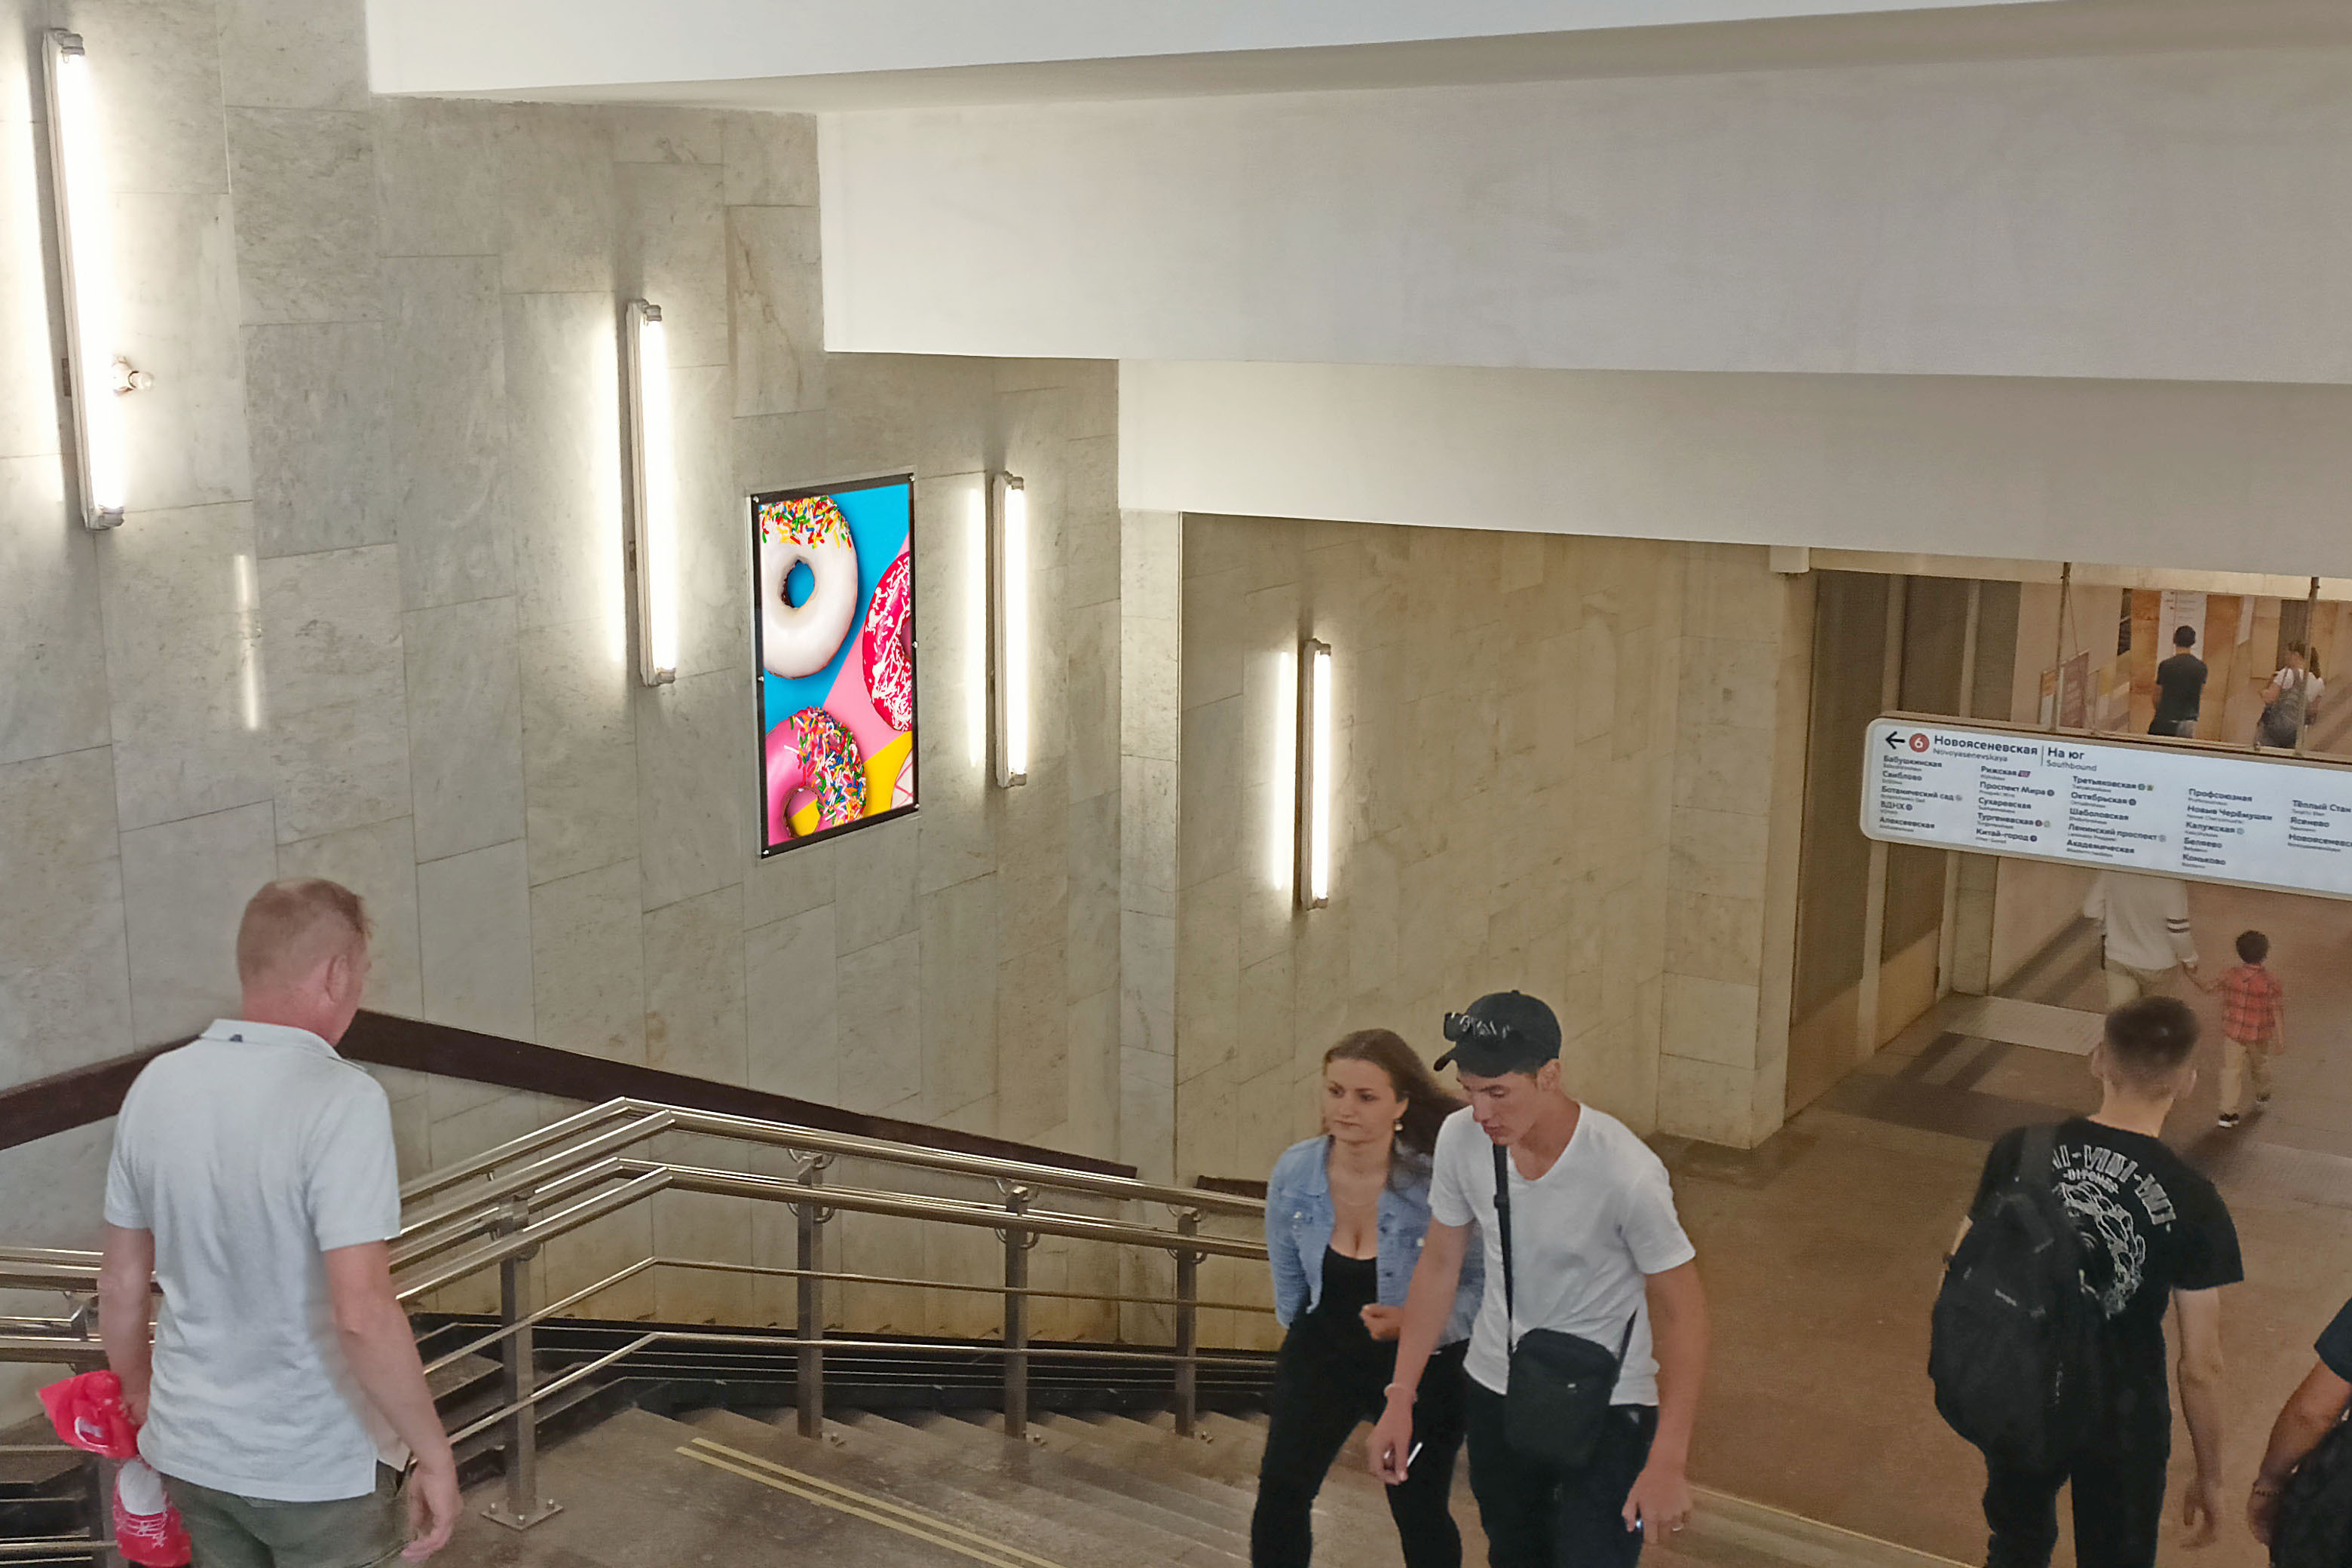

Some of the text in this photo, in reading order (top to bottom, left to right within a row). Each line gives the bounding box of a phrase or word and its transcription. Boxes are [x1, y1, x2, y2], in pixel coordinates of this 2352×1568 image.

[1934, 735, 2038, 755] Новоясеневская
[2047, 746, 2085, 761] На юг
[2046, 760, 2097, 772] Southbound
[1980, 781, 2020, 793] Проспект
[2021, 786, 2045, 796] Мира
[2073, 776, 2136, 789] Третьяковская
[1940, 792, 1954, 801] сад
[2188, 788, 2252, 802] Профсоюзная
[1880, 801, 1905, 810] ВДНХ
[1978, 797, 2032, 810] Сухаревская
[2069, 807, 2129, 821] Шаболовская
[2185, 821, 2235, 834] Калужская
[2290, 816, 2329, 828] Ясенево
[2068, 822, 2115, 836] Ленинский
[2116, 829, 2158, 842] проспект
